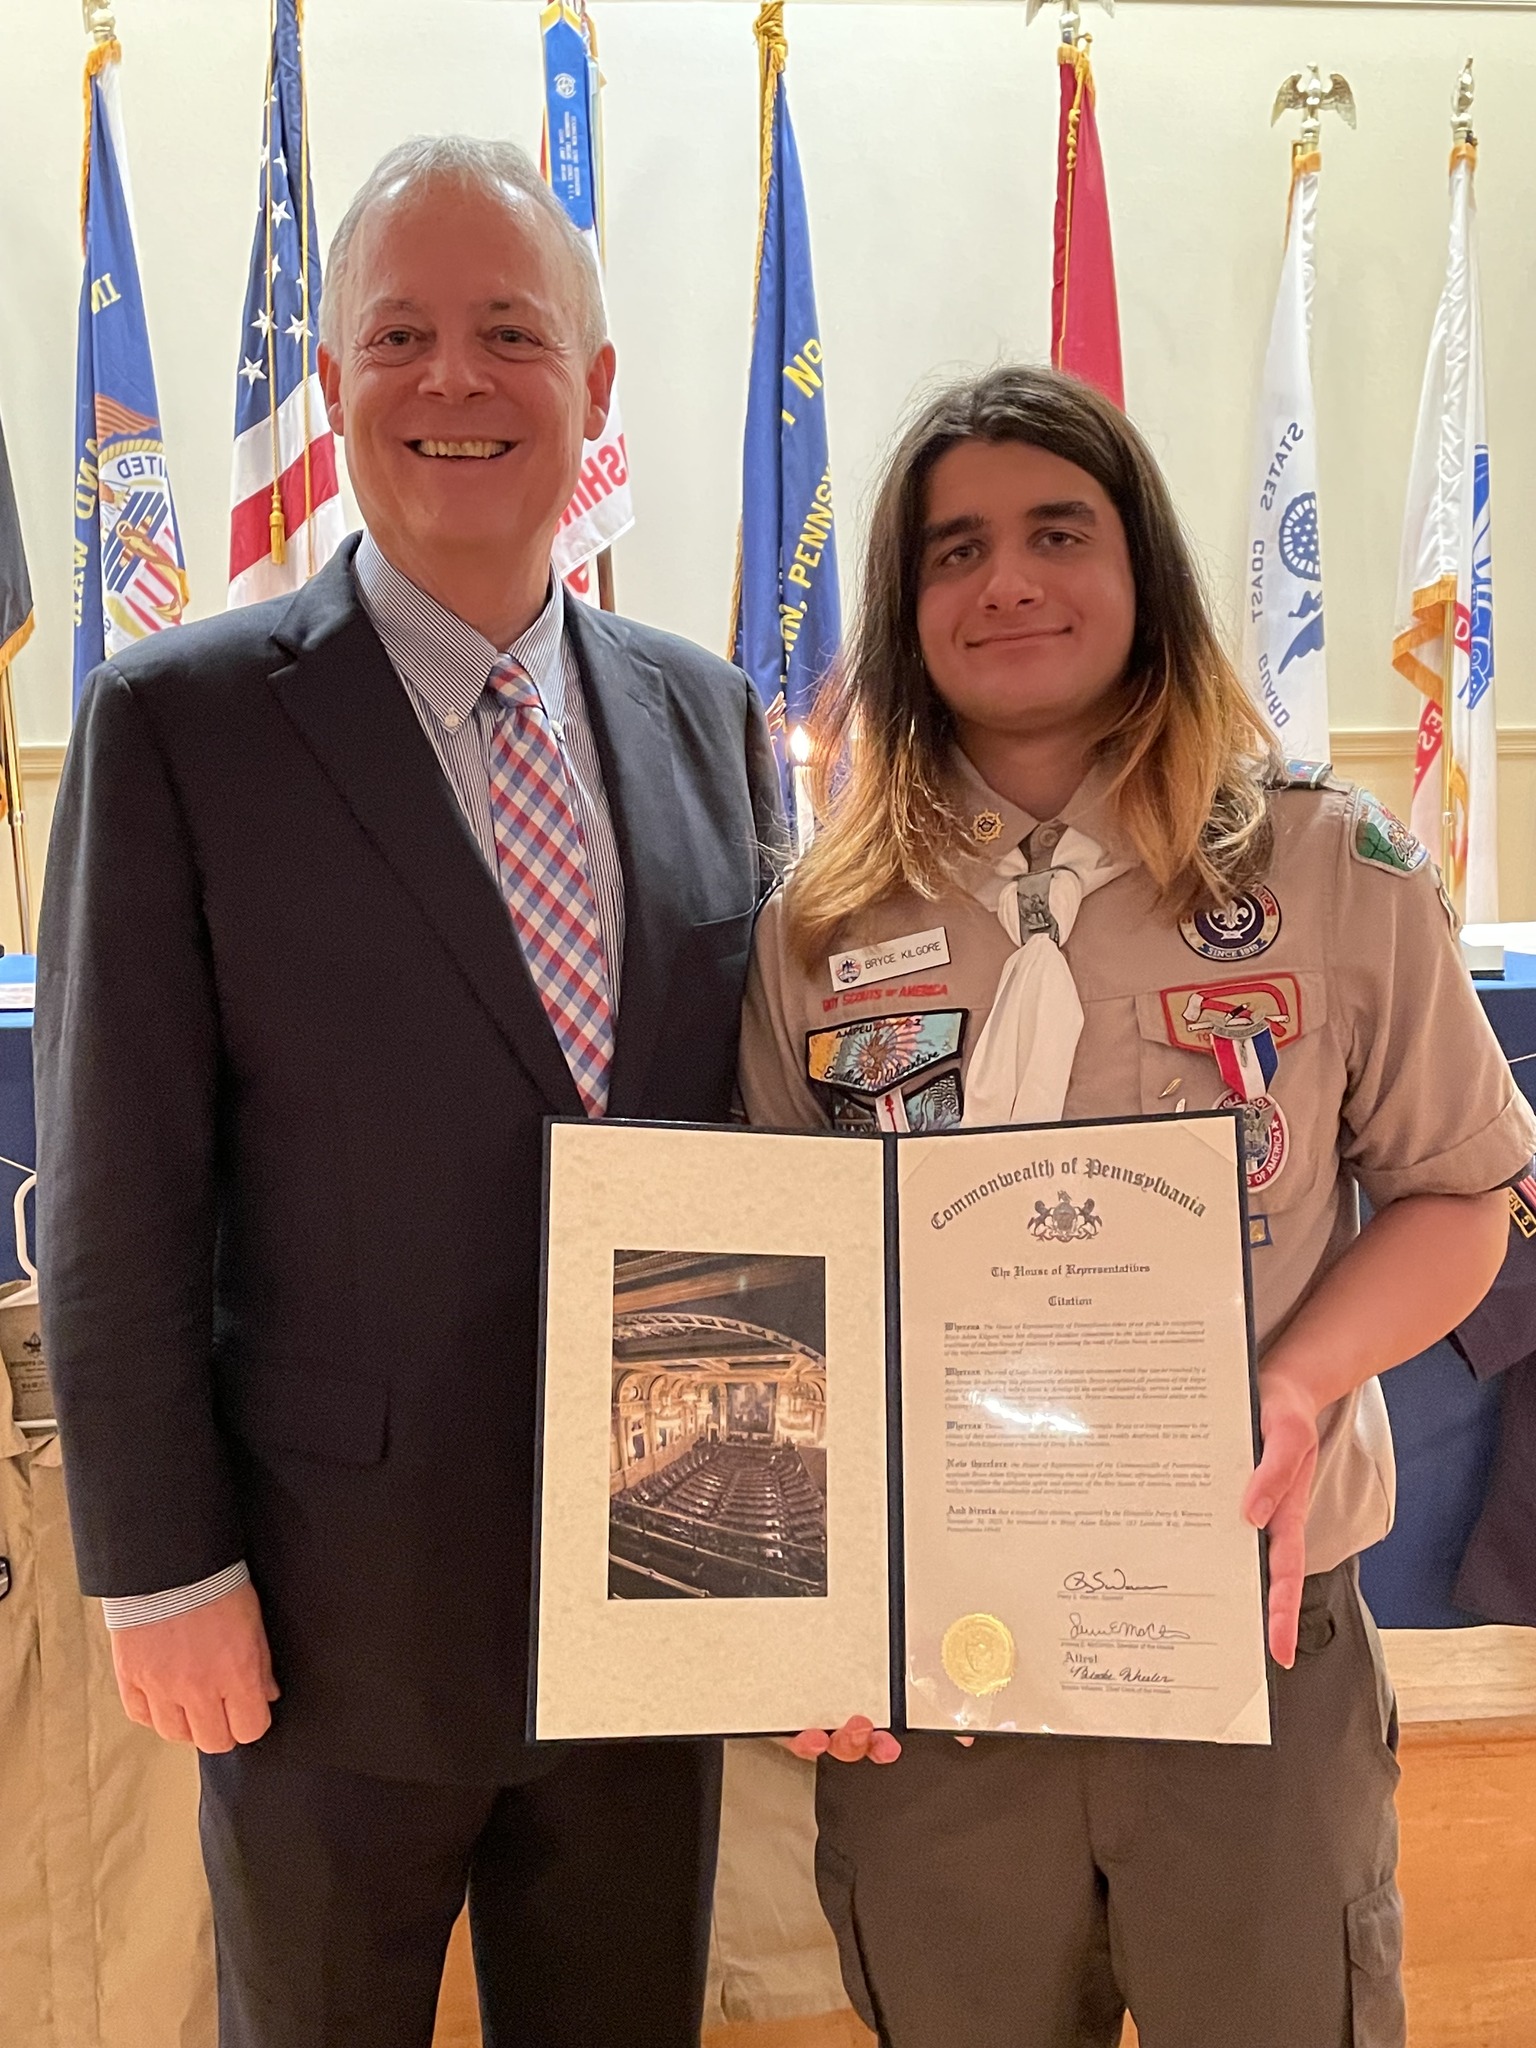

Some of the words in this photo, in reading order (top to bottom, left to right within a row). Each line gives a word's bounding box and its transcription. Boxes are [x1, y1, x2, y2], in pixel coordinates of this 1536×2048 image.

[864, 952, 896, 970] BRYCE
[901, 941, 942, 960] KILGORE
[1207, 948, 1238, 958] SINCE
[1240, 944, 1259, 955] 1910
[842, 988, 883, 1006] SCOUTS
[899, 984, 948, 998] AMERICA
[1255, 1171, 1267, 1184] OF
[1265, 1129, 1283, 1175] AMERICA
[931, 1159, 1055, 1230] Commonwealth
[1061, 1157, 1078, 1175] of
[1083, 1158, 1207, 1218] Pennsylvania
[991, 1267, 1010, 1280] The
[1014, 1265, 1049, 1280] House
[1052, 1264, 1063, 1276] of
[1065, 1263, 1151, 1278] Representatives
[1048, 1295, 1093, 1307] Citation
